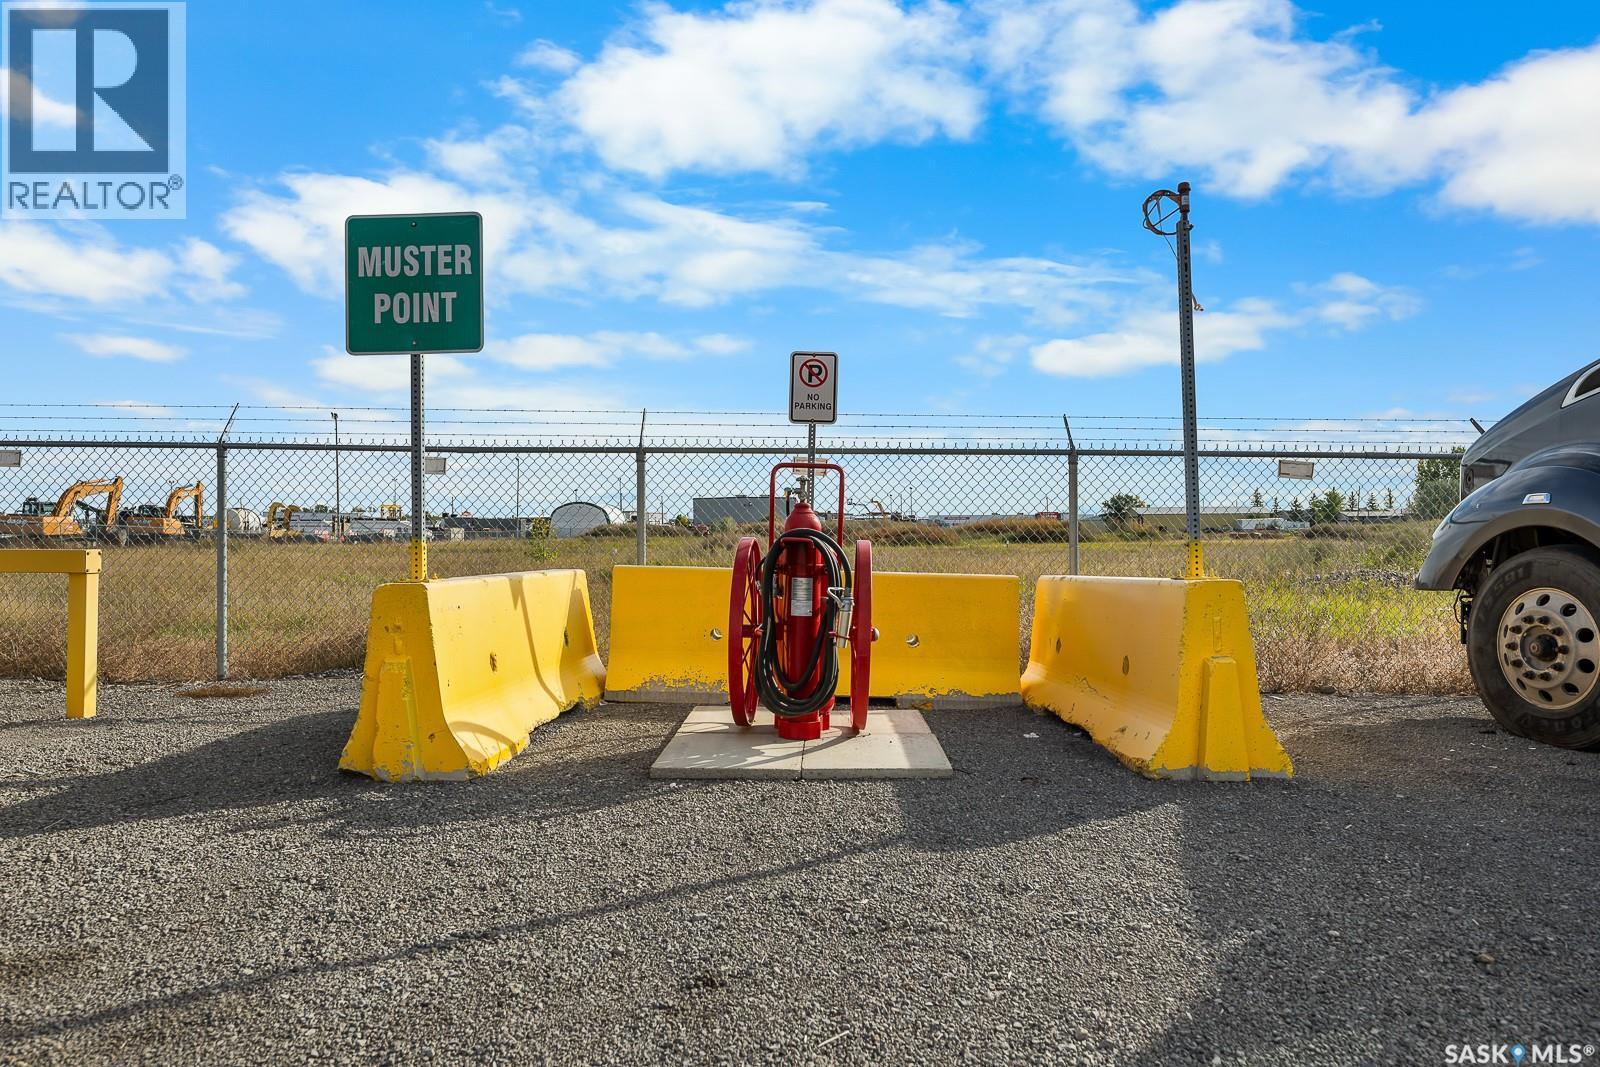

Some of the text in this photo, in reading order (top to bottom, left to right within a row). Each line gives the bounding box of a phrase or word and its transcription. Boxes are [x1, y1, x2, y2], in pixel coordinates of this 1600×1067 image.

[357, 244, 472, 277] MUSTER
[374, 291, 457, 324] POINT
[794, 402, 832, 410] PARKING
[807, 393, 820, 401] NO
